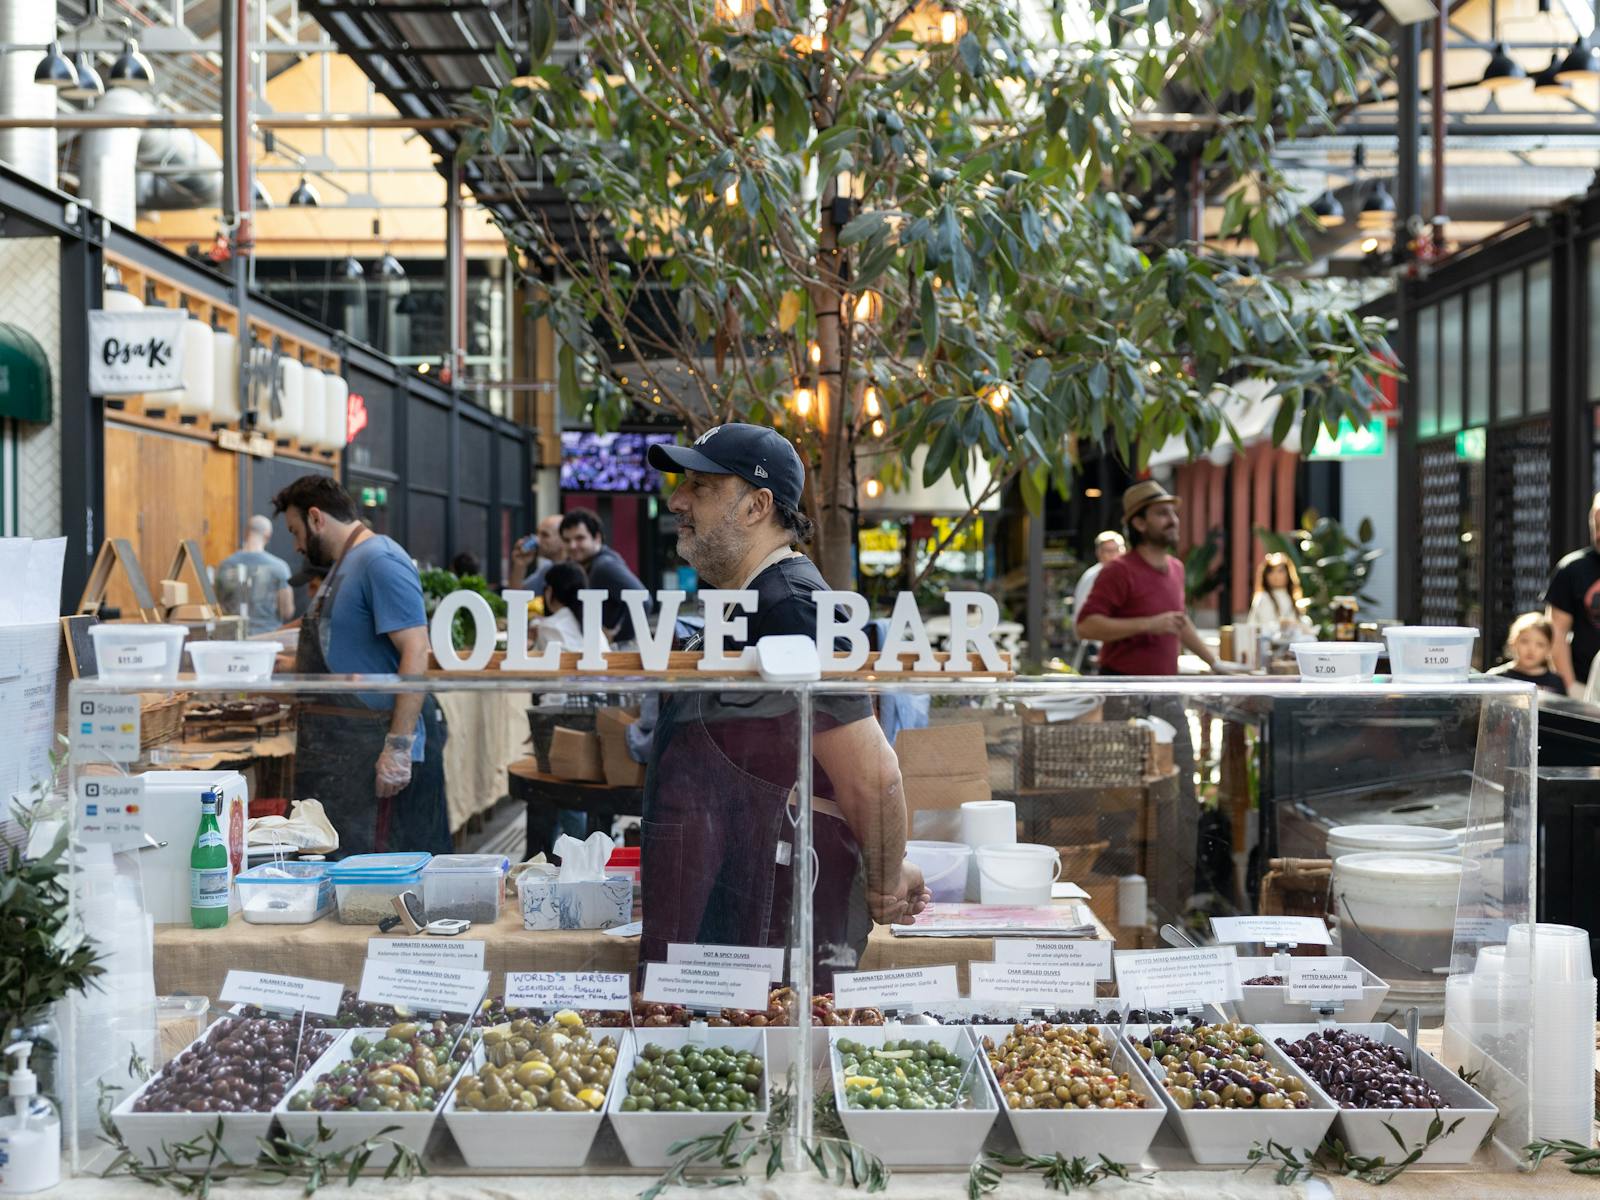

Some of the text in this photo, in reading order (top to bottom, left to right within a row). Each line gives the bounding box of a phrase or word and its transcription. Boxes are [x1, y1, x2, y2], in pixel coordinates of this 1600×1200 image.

[430, 589, 1010, 672] OLIVE BAR
[118, 656, 142, 664] $11.00
[98, 704, 134, 714] Square
[103, 785, 139, 796] Square
[413, 969, 443, 978] MARINATED
[575, 974, 624, 982] LARGEST
[853, 974, 883, 982] MARINATED
